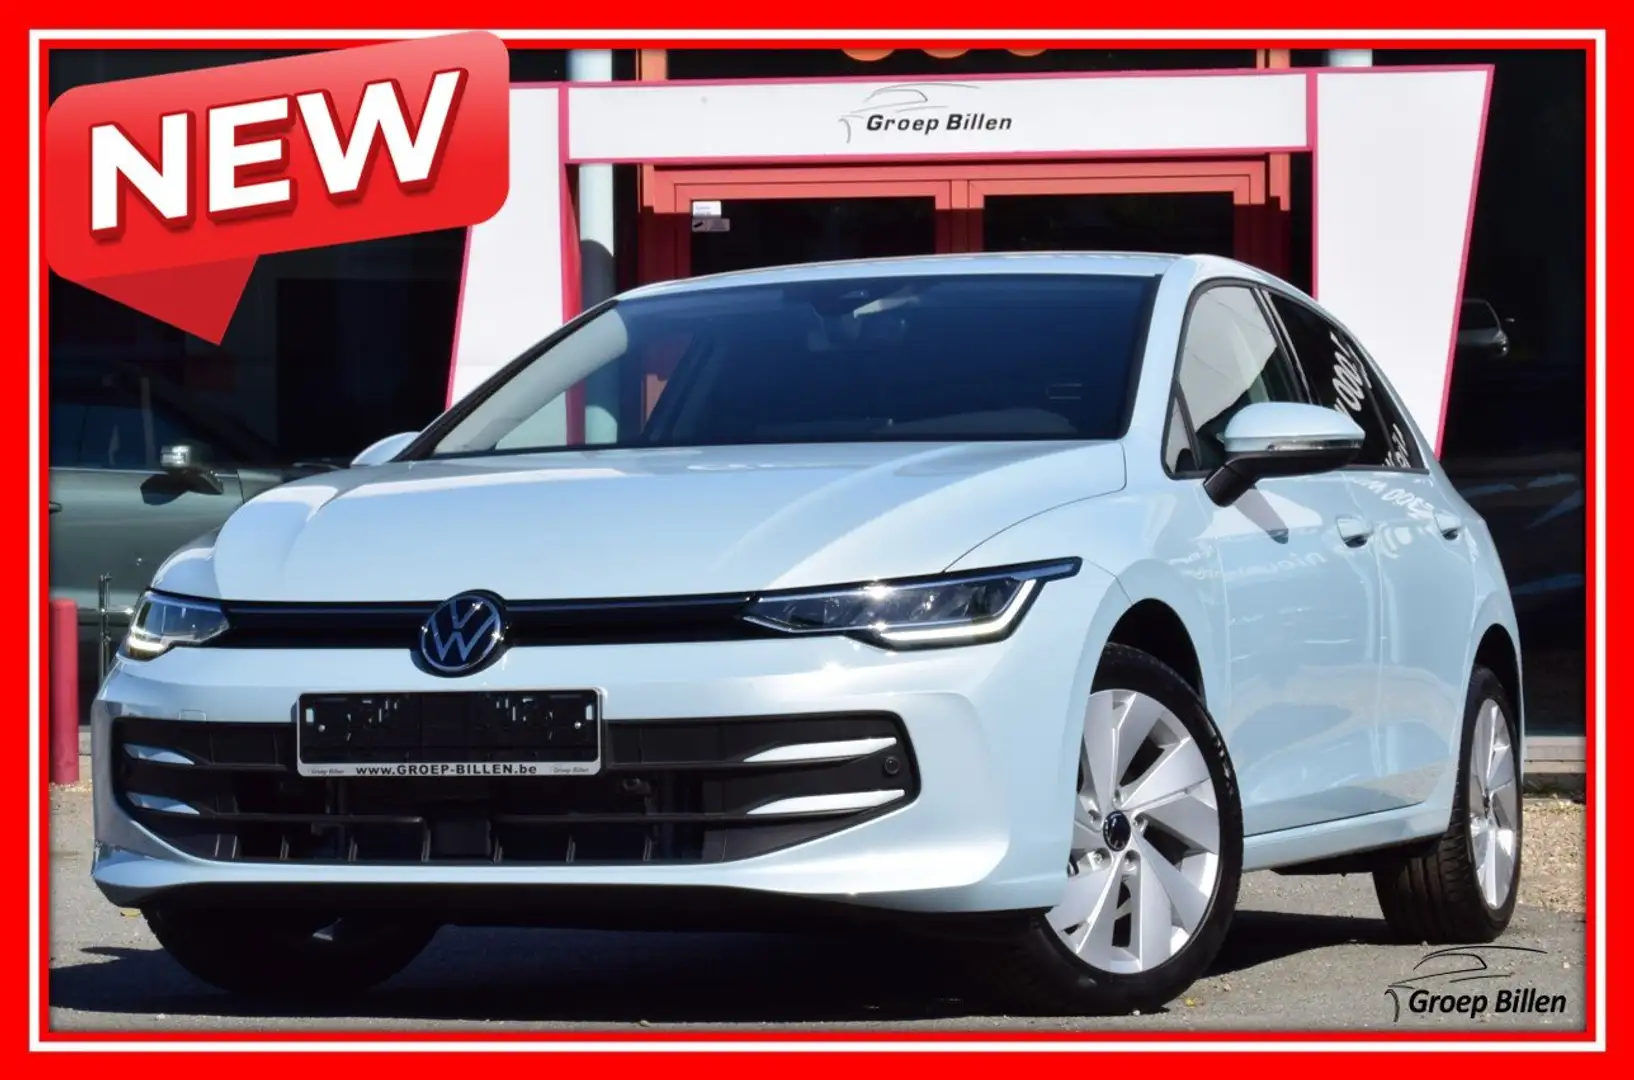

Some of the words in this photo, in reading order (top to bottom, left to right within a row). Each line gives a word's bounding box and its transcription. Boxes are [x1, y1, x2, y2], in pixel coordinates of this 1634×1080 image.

[866, 114, 940, 136] Groep
[946, 113, 1012, 131] Billen
[355, 763, 538, 776] www.GROEP-BILLEN.be
